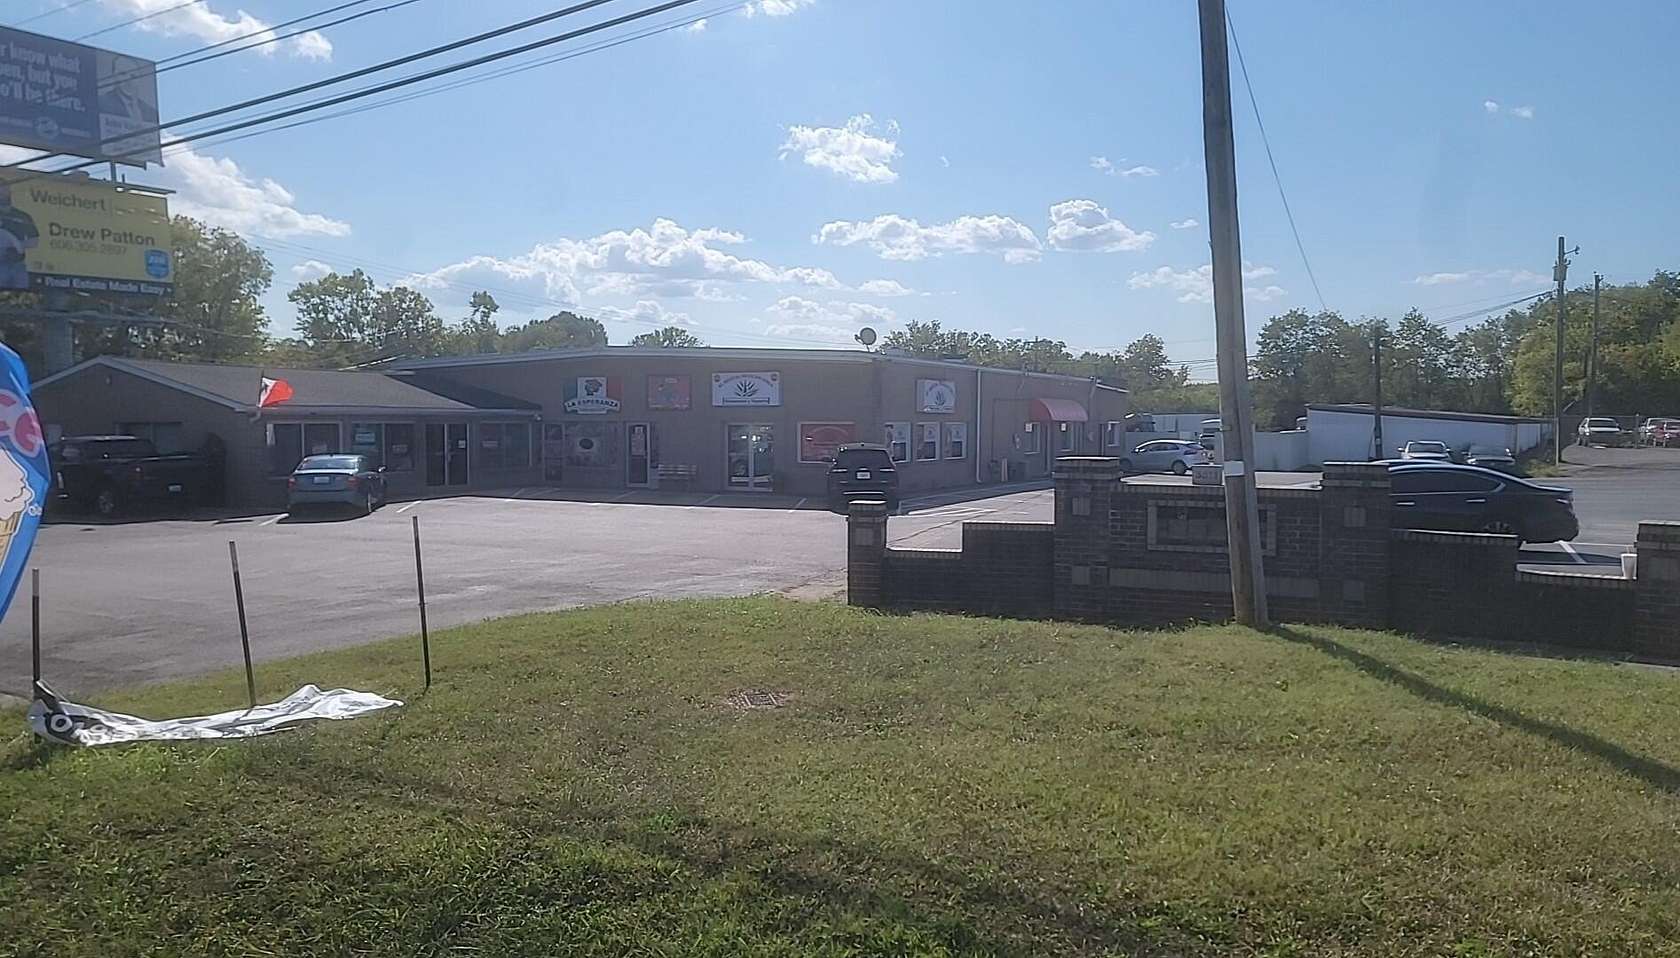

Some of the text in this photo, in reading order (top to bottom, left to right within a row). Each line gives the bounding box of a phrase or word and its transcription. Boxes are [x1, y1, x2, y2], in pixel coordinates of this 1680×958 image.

[10, 41, 46, 65] know
[48, 53, 81, 73] what
[28, 64, 51, 87] but
[53, 74, 78, 90] you
[25, 83, 44, 103] be
[30, 187, 106, 211] Weichert
[49, 222, 155, 246] Drew Patton
[45, 277, 70, 288] Real
[71, 278, 107, 291] Estate
[108, 281, 138, 293] Made
